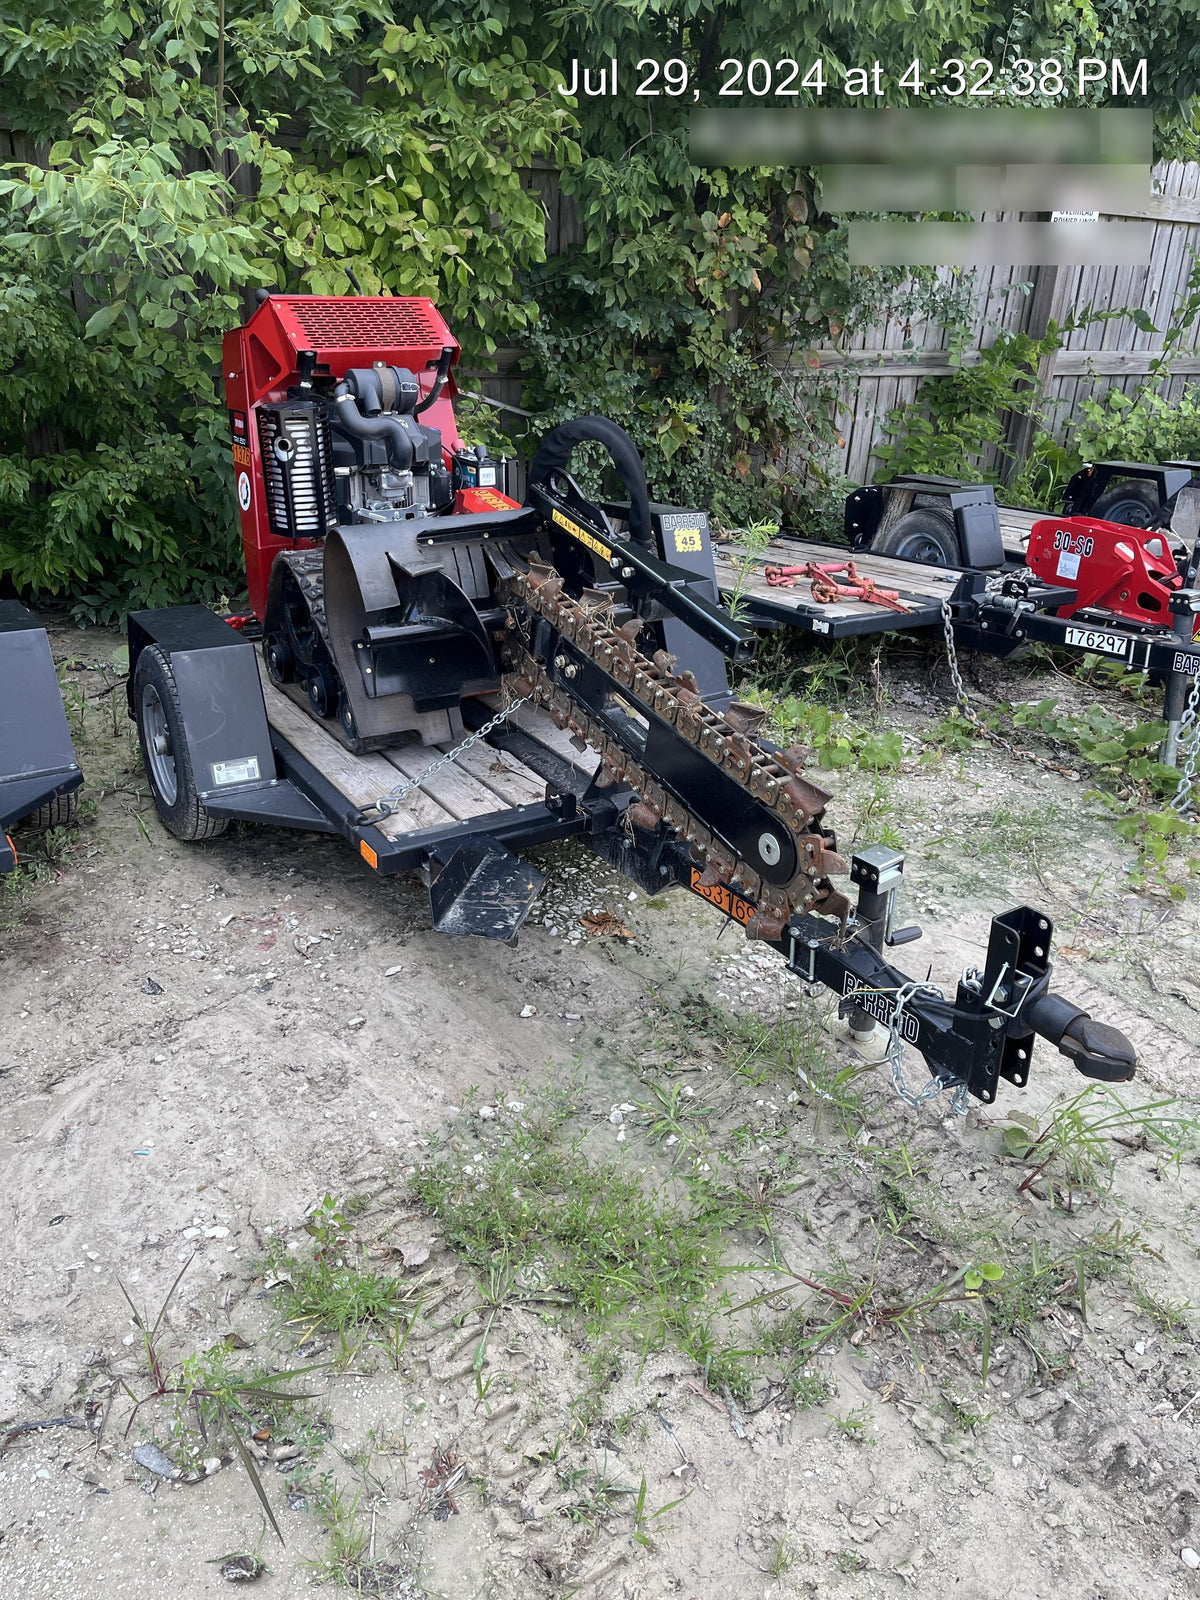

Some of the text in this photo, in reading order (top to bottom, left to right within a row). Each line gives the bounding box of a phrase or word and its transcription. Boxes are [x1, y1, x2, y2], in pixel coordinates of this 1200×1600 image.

[662, 513, 707, 531] BARRETO
[681, 536, 696, 546] 45
[1053, 530, 1094, 557] 30-SG
[1067, 629, 1126, 653] 176297
